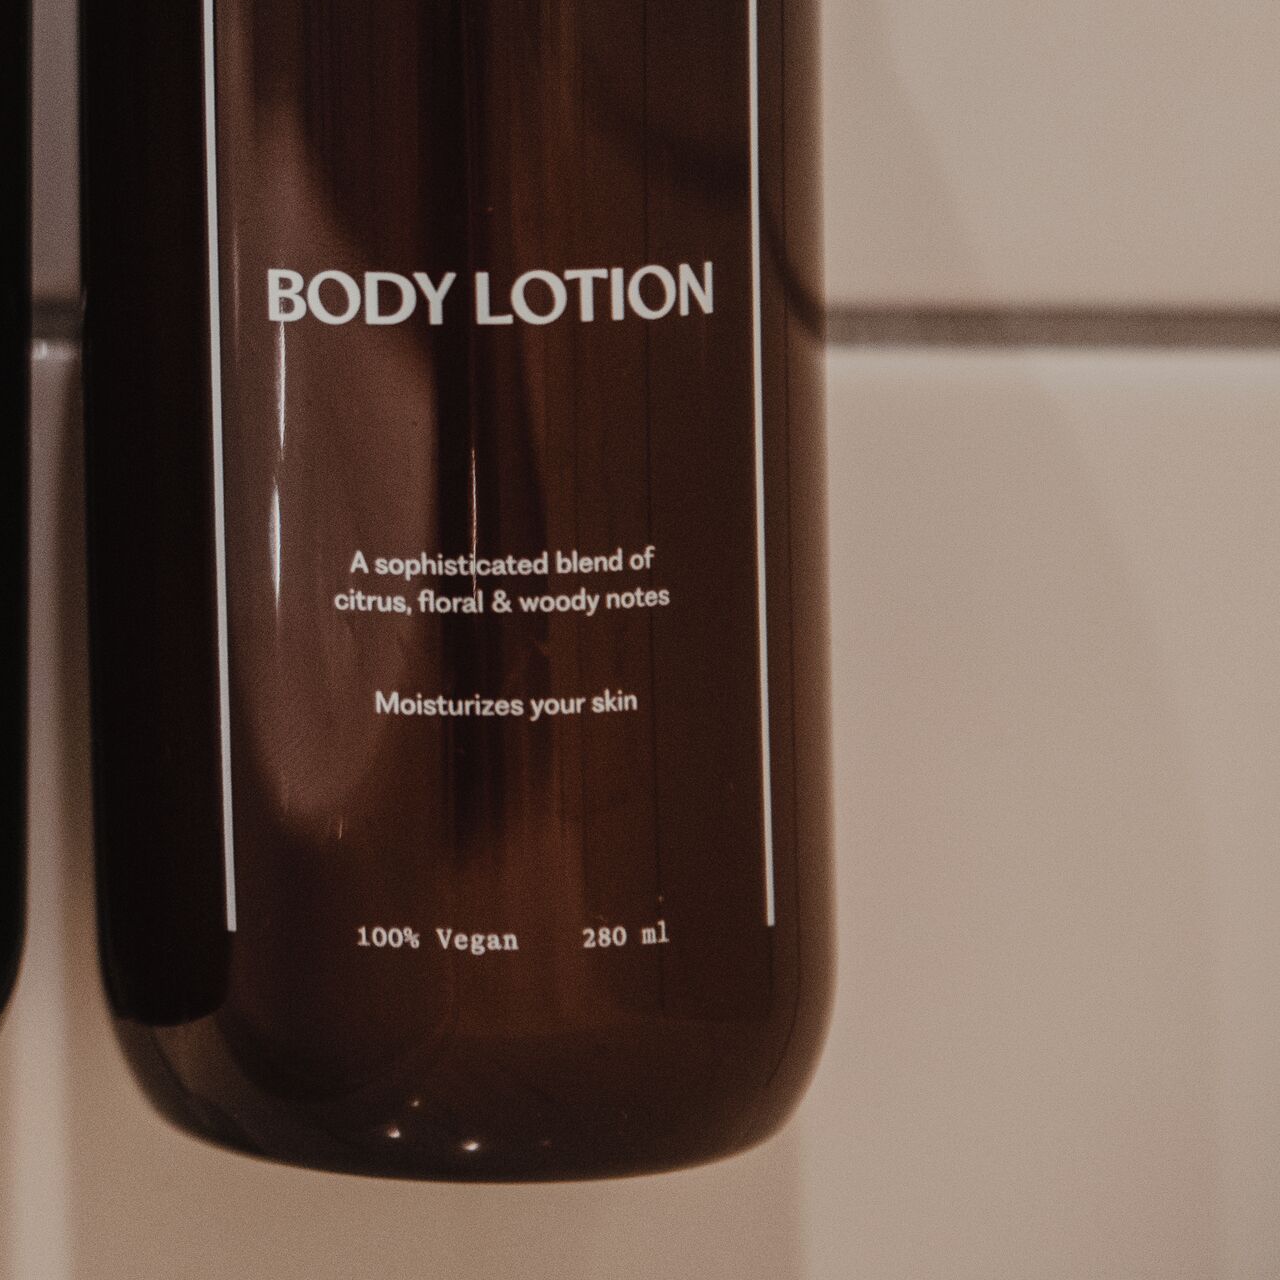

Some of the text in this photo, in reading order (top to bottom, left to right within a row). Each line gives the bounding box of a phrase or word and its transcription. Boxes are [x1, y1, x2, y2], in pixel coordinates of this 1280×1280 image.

[267, 261, 714, 325] BODY LOTION
[349, 545, 656, 581] A sophisticated blend of
[333, 586, 671, 617] citrus, floral & woody notes
[374, 688, 638, 722] Moisturizes your skin
[357, 925, 520, 956] 100% Vegan
[582, 919, 670, 949] 280 ml
